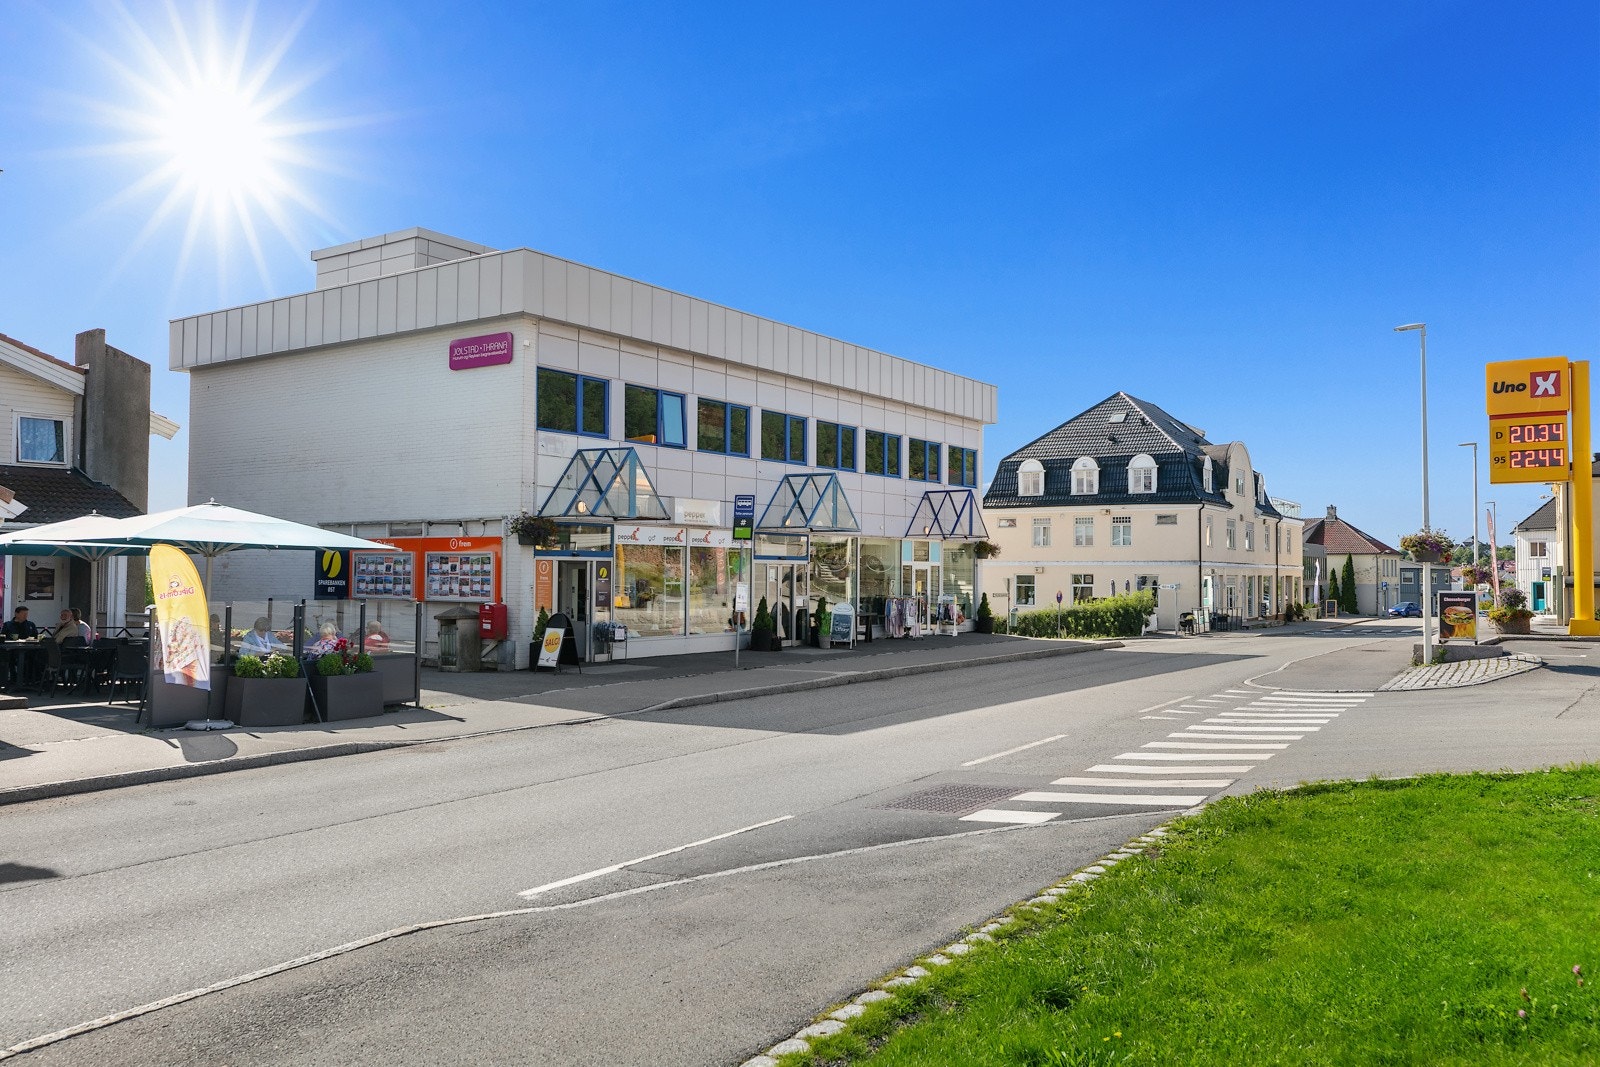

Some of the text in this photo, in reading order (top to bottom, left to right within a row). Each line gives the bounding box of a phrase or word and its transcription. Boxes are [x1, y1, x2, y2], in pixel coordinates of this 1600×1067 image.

[1493, 373, 1557, 396] Uno X
[1495, 423, 1563, 443] D 20.34
[1494, 449, 1564, 468] 95 22.44
